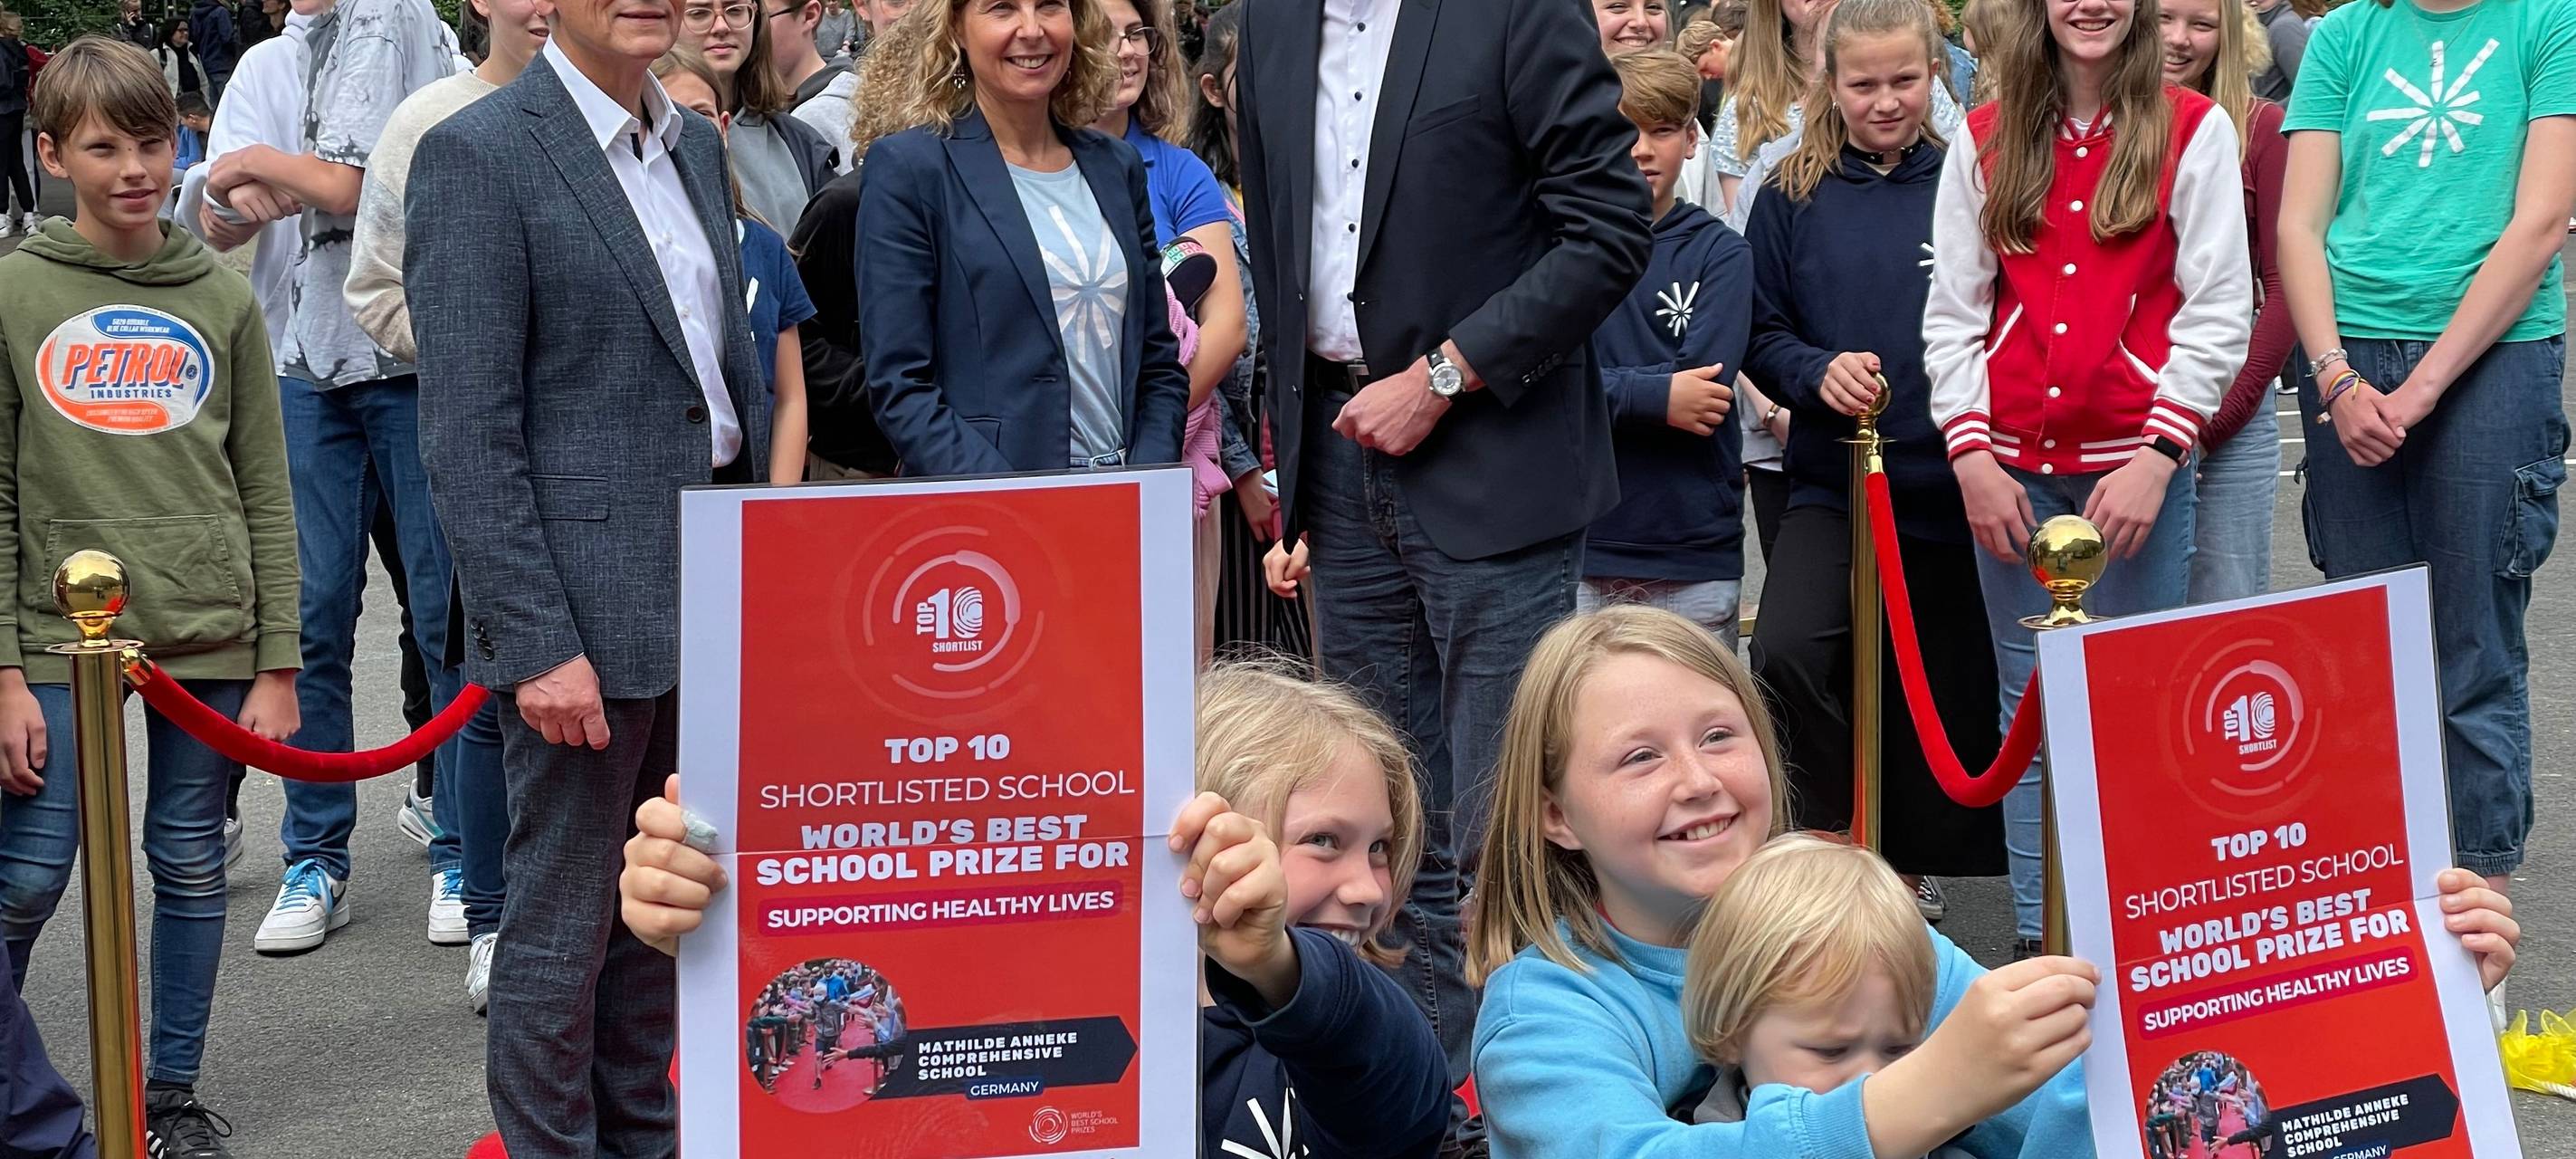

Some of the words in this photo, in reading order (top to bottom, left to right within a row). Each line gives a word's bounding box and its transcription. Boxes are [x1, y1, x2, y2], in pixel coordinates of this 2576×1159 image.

[61, 342, 189, 390] PETROL
[91, 389, 172, 399] INDUSTRIES
[917, 602, 934, 635] TOP
[932, 640, 983, 652] SHORTLIST
[2223, 710, 2238, 740] TOP
[884, 735, 959, 764] TOP
[968, 733, 1010, 760] 10
[2239, 739, 2276, 754] SHORTLIST
[759, 777, 990, 809] SHORTLISTED
[997, 770, 1135, 800] SCHOOL
[801, 819, 974, 850] WORLD'S
[987, 814, 1087, 842] BEST
[2211, 829, 2267, 861] TOP
[2274, 822, 2306, 848] 10
[757, 852, 918, 886] SCHOOL
[929, 845, 1043, 877] PRIZE
[1055, 841, 1130, 870] FOR
[2125, 865, 2295, 919] SHORTLISTED
[2301, 843, 2404, 883] SCHOOL
[768, 903, 927, 928] SUPPORTING
[932, 895, 1045, 919] HEALTHY
[1048, 891, 1114, 912] LIVES
[2160, 905, 2288, 954] WORLD'S
[2296, 888, 2371, 925] BEST
[2131, 944, 2250, 991] SCHOOL
[2256, 922, 2344, 964] PRIZE
[2350, 908, 2411, 943] FOR
[2144, 989, 2264, 1031] SUPPORTING
[2266, 969, 2352, 1003] HEALTHY
[2354, 956, 2410, 984] LIVES
[918, 1047, 1063, 1067] COMPREHENSIVE
[919, 1037, 1006, 1054] MATHILDE
[1010, 1032, 1077, 1048] ANNEKE
[918, 1066, 987, 1080] SCHOOL
[969, 1081, 1039, 1097] GERMANY
[1071, 1111, 1102, 1119] WORLD'S
[1071, 1118, 1089, 1126] BEST
[1071, 1125, 1095, 1134] PRIZES
[2281, 1106, 2352, 1133] MATHILDE
[2354, 1094, 2409, 1116] ANNEKE
[2285, 1109, 2400, 1145] COMPREHENSIVE
[2287, 1136, 2342, 1158] SCHOOL
